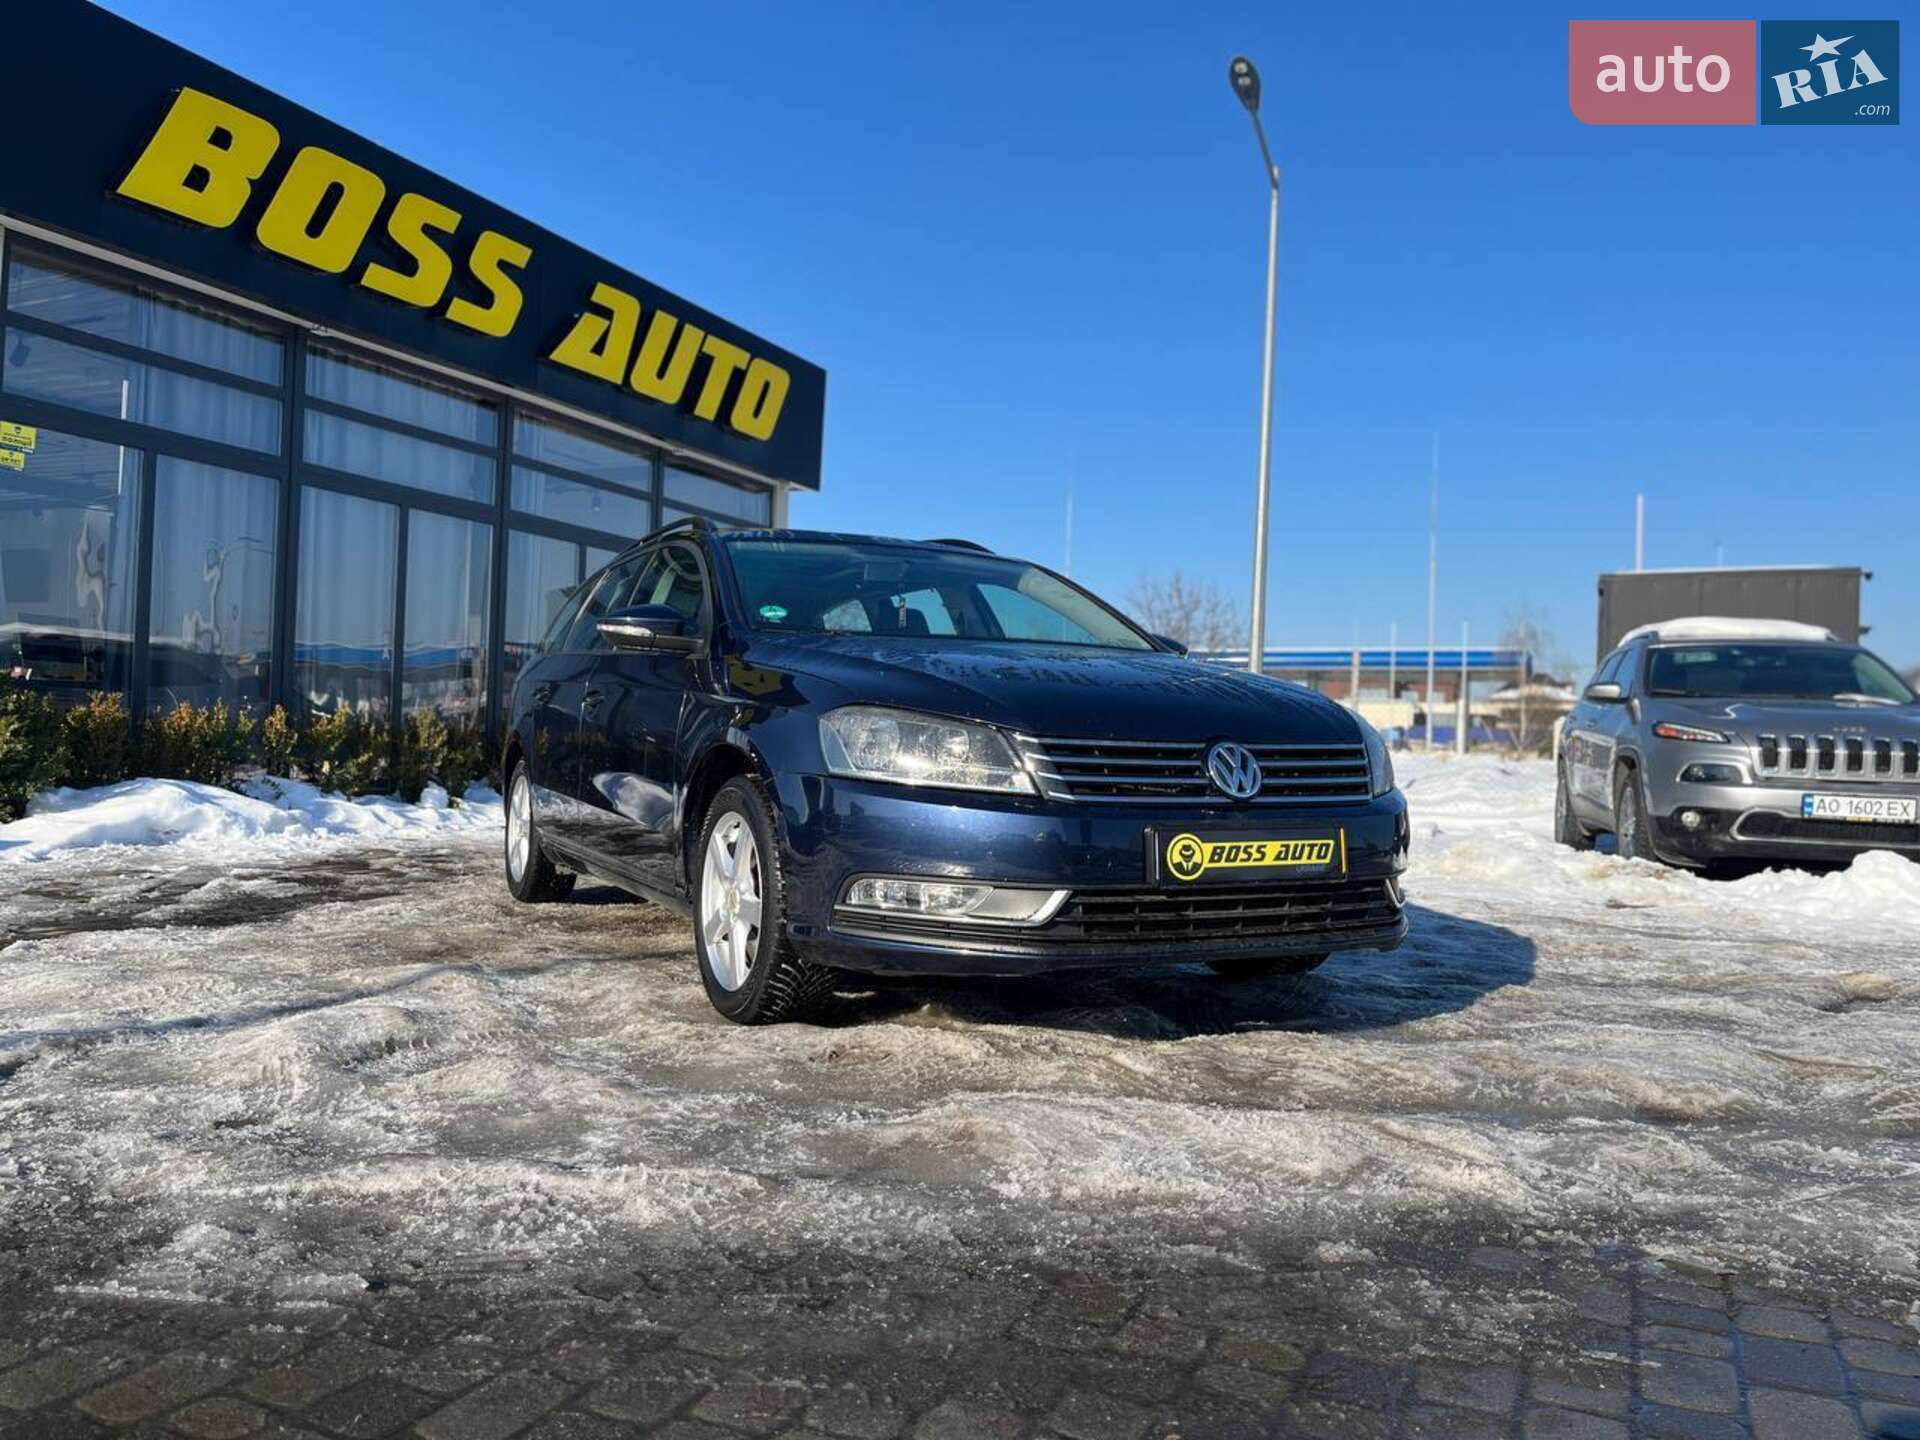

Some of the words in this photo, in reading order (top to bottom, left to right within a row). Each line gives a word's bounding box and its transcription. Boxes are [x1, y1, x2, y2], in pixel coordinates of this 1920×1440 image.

[116, 86, 533, 338] BOSS
[549, 281, 791, 441] AUTO
[1816, 798, 1840, 813] AO
[1847, 800, 1883, 816] 1602
[1887, 801, 1911, 817] EX
[1208, 844, 1267, 863] BOSS
[1273, 842, 1331, 861] AUTO
